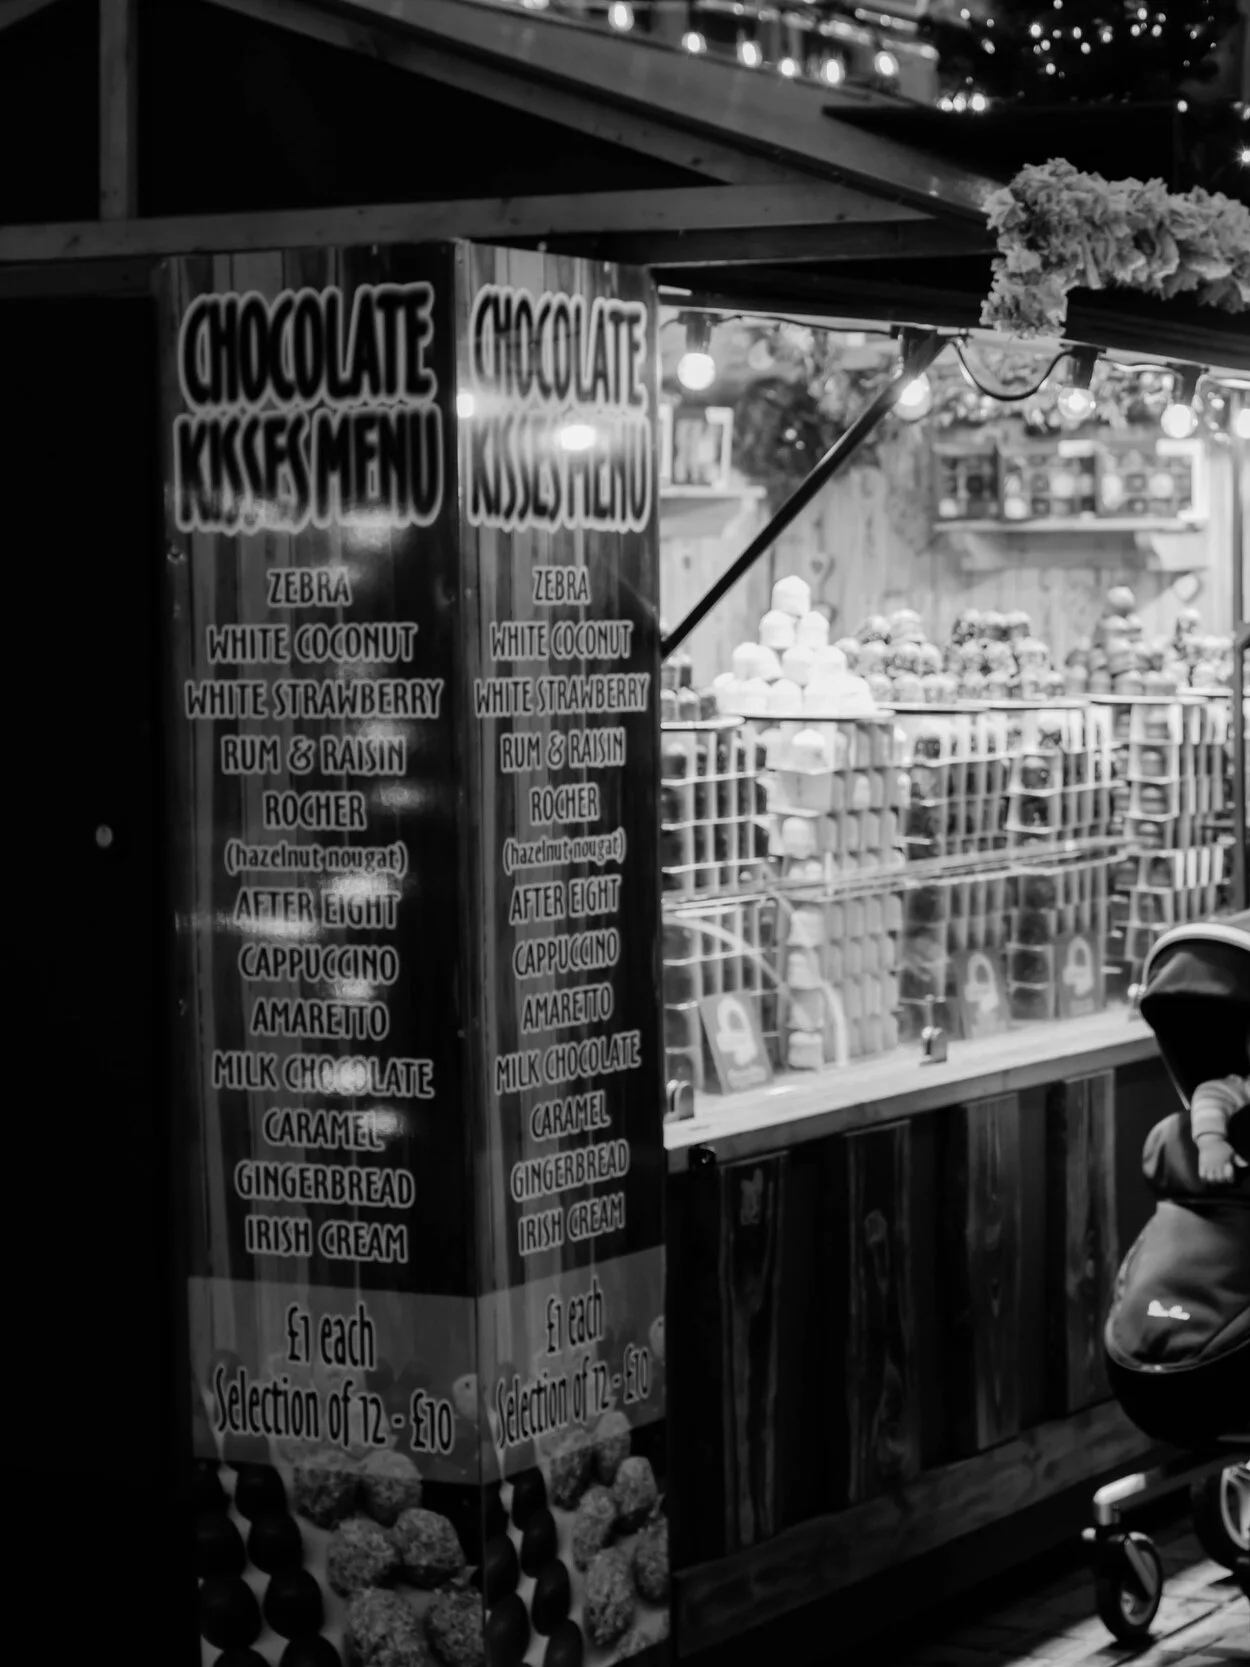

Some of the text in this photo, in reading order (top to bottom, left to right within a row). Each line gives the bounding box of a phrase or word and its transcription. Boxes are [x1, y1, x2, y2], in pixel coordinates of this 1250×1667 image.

[179, 283, 437, 412] CHOCOLATE
[469, 285, 647, 415] CHOCOLATE
[173, 402, 443, 535] KISSES MENU
[267, 565, 353, 606] ZEBRA
[532, 565, 591, 606] ZEBRA
[206, 622, 417, 663] WHITE COCONUT
[490, 620, 633, 659] WHITE COCONUT
[185, 678, 444, 719] WHITE STRAWBERRY
[474, 673, 651, 716] WHITE STRAWBERRY
[221, 736, 406, 775] RUM & RAISIN
[500, 727, 626, 772] RUM & RAISIN
[263, 790, 367, 830] ROCHER
[529, 783, 599, 825] ROCHER
[225, 838, 408, 878] (hazelnut nougat)
[504, 828, 626, 875] (hazelnut nougat)
[234, 888, 401, 929] AFTER EIGHT
[510, 874, 621, 925] AFTER EIGHT
[239, 943, 398, 983] CAPPUCCINO
[514, 928, 619, 979] CAPPUCCINO
[250, 999, 389, 1040] AMARETTO
[522, 982, 613, 1033] AMARETTO
[212, 1052, 277, 1090] MILK
[495, 1031, 641, 1095] MILK CHOCOLATE
[263, 1108, 385, 1150] CARAMEL
[530, 1091, 610, 1141] CARAMEL
[235, 1162, 415, 1208] GINGERBREAD
[511, 1139, 629, 1203] GINGERBREAD
[245, 1214, 408, 1263] IRISH CREAM
[518, 1193, 626, 1256] IRISH CREAM
[287, 1303, 376, 1371] £1 each
[546, 1275, 602, 1355] £1 each
[213, 1366, 319, 1441] Selection
[328, 1379, 354, 1448] of
[359, 1395, 387, 1446] 12
[410, 1388, 454, 1454] £10
[497, 1371, 569, 1448] Selection
[572, 1353, 591, 1424] of
[593, 1361, 611, 1411] 12
[623, 1344, 651, 1404] £10
